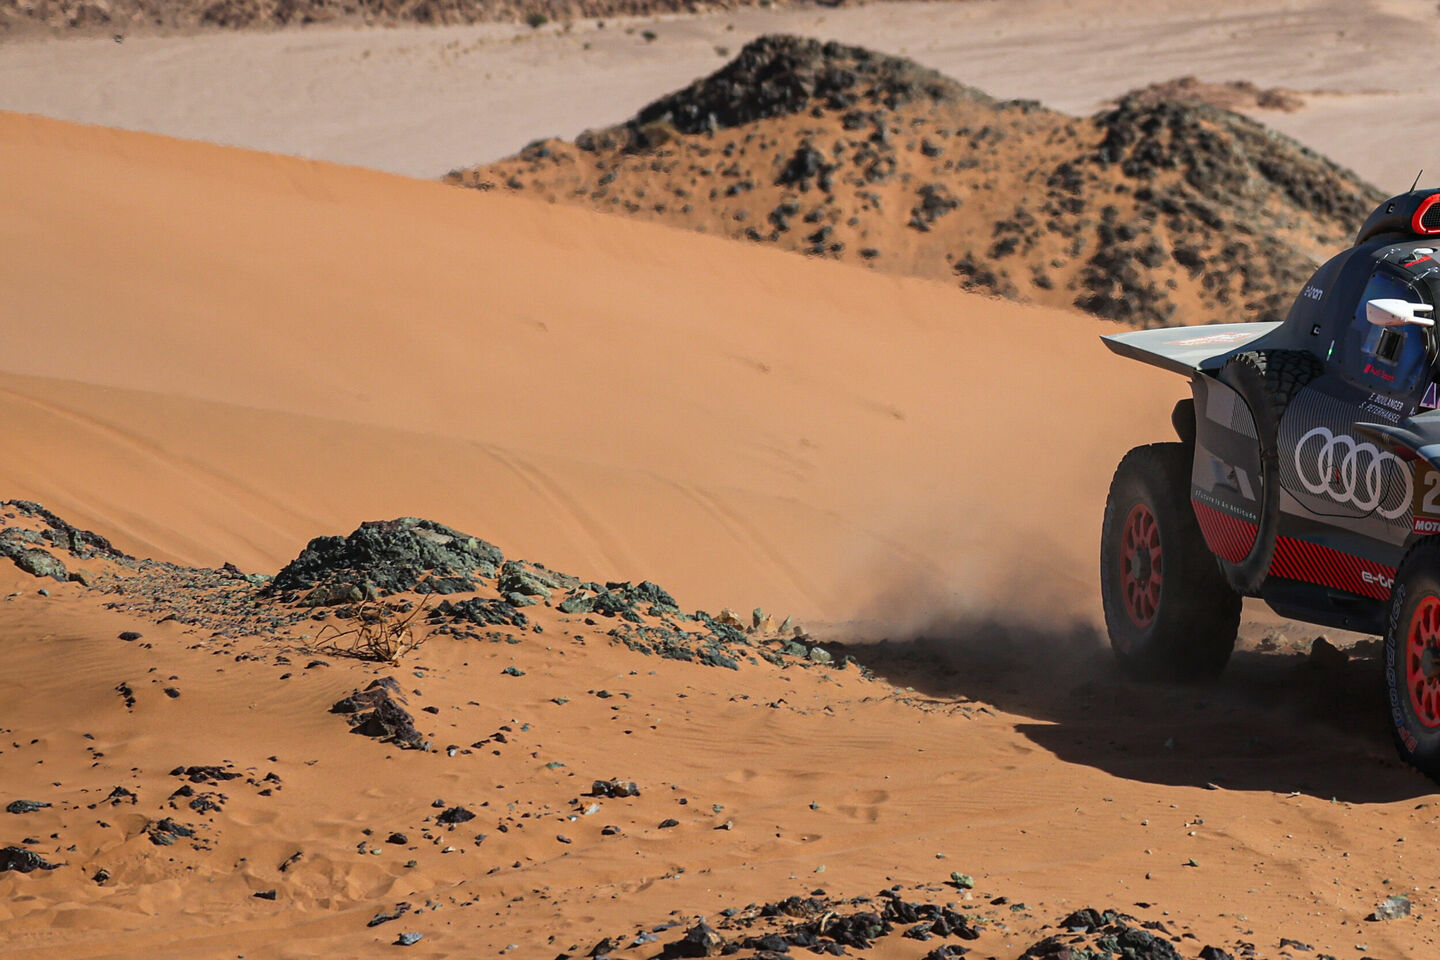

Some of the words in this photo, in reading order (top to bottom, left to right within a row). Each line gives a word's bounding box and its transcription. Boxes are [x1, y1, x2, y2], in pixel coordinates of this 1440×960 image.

[1376, 394, 1404, 411] BOULANGER
[1230, 504, 1257, 520] Attitude
[1361, 570, 1394, 589] e-tr
